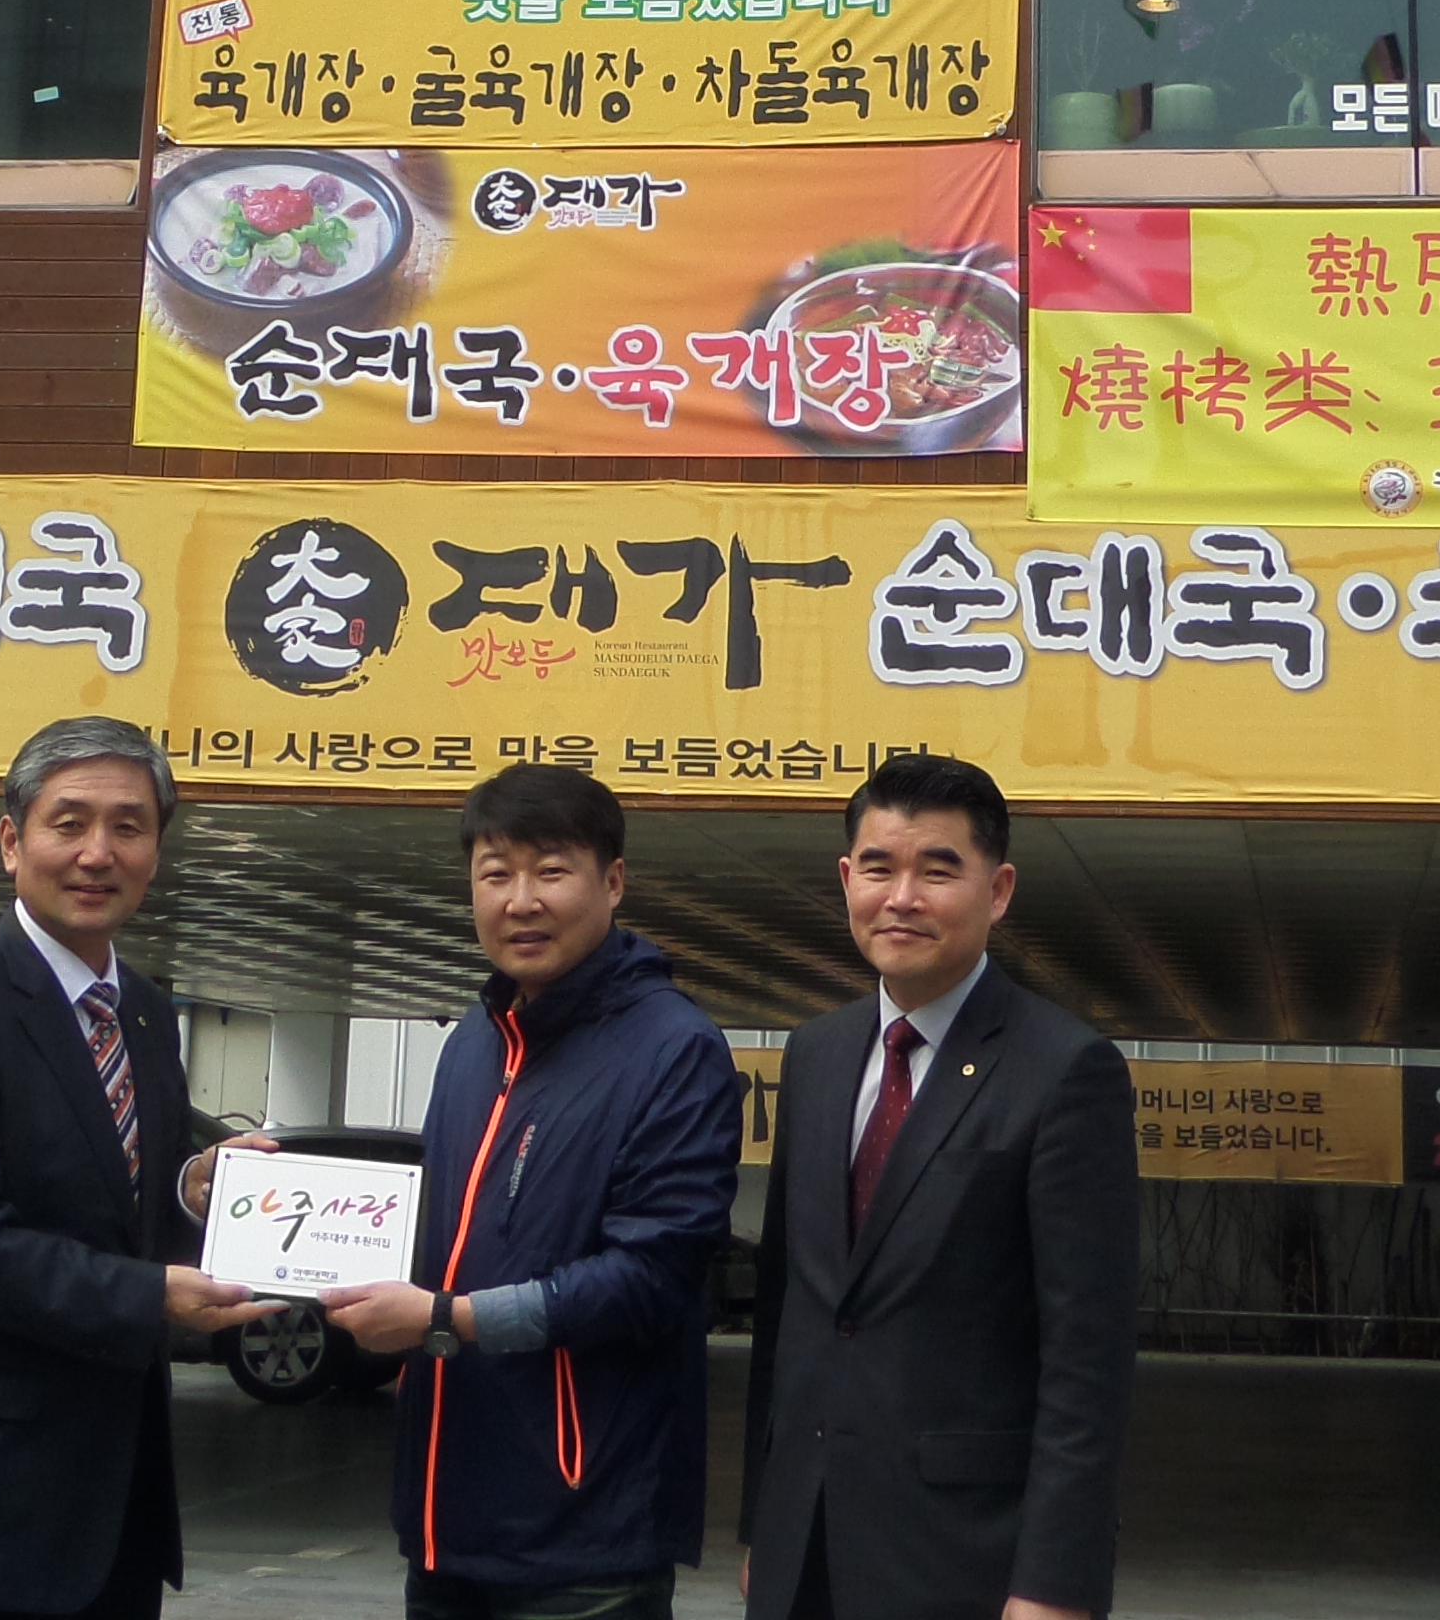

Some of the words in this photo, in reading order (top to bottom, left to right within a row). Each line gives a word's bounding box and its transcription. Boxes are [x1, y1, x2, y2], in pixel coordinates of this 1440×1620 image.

[189, 1, 243, 36] 전통
[1331, 85, 1409, 132] 모든
[446, 627, 576, 688] 맛보듬
[593, 639, 632, 651] Korean
[634, 639, 689, 651] Restaurant
[593, 652, 674, 665] MASBODEUM
[676, 653, 720, 665] DAEGA
[593, 666, 671, 678] SUNDAEGUK
[274, 731, 477, 773] 사랑으로
[1133, 1087, 1215, 1114] 머니의
[1224, 1088, 1324, 1115] 사랑으로
[229, 1188, 314, 1253] 아주
[319, 1193, 399, 1228] 사랑
